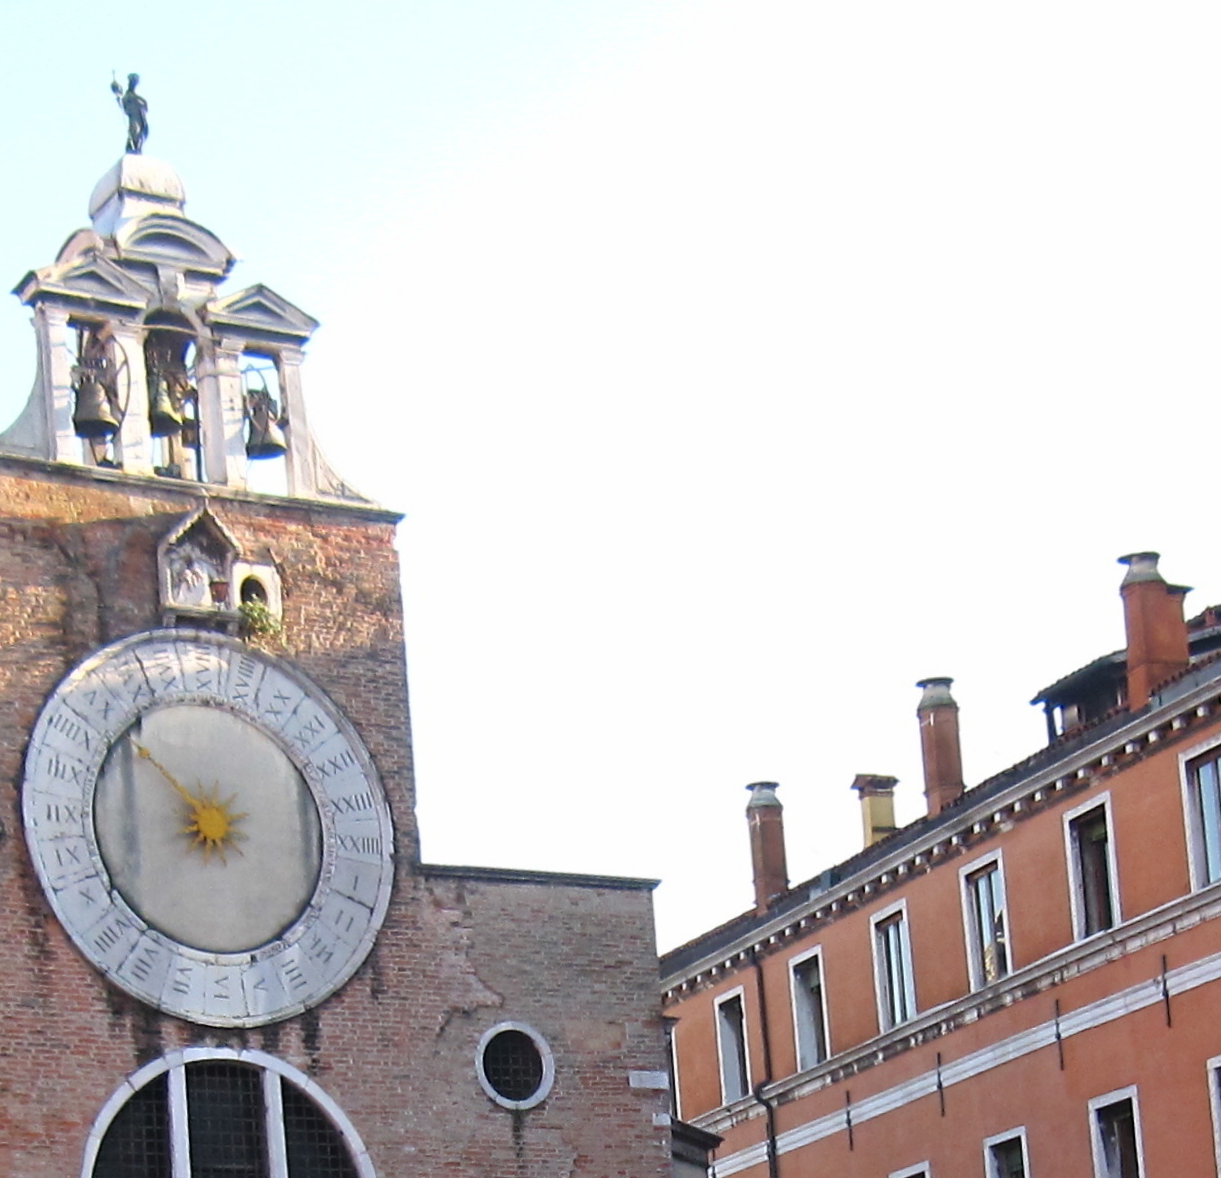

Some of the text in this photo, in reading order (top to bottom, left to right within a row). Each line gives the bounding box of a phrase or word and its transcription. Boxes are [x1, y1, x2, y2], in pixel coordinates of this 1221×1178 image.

[264, 688, 292, 722] XX
[293, 714, 326, 749] XXI
[316, 750, 356, 779] XXII
